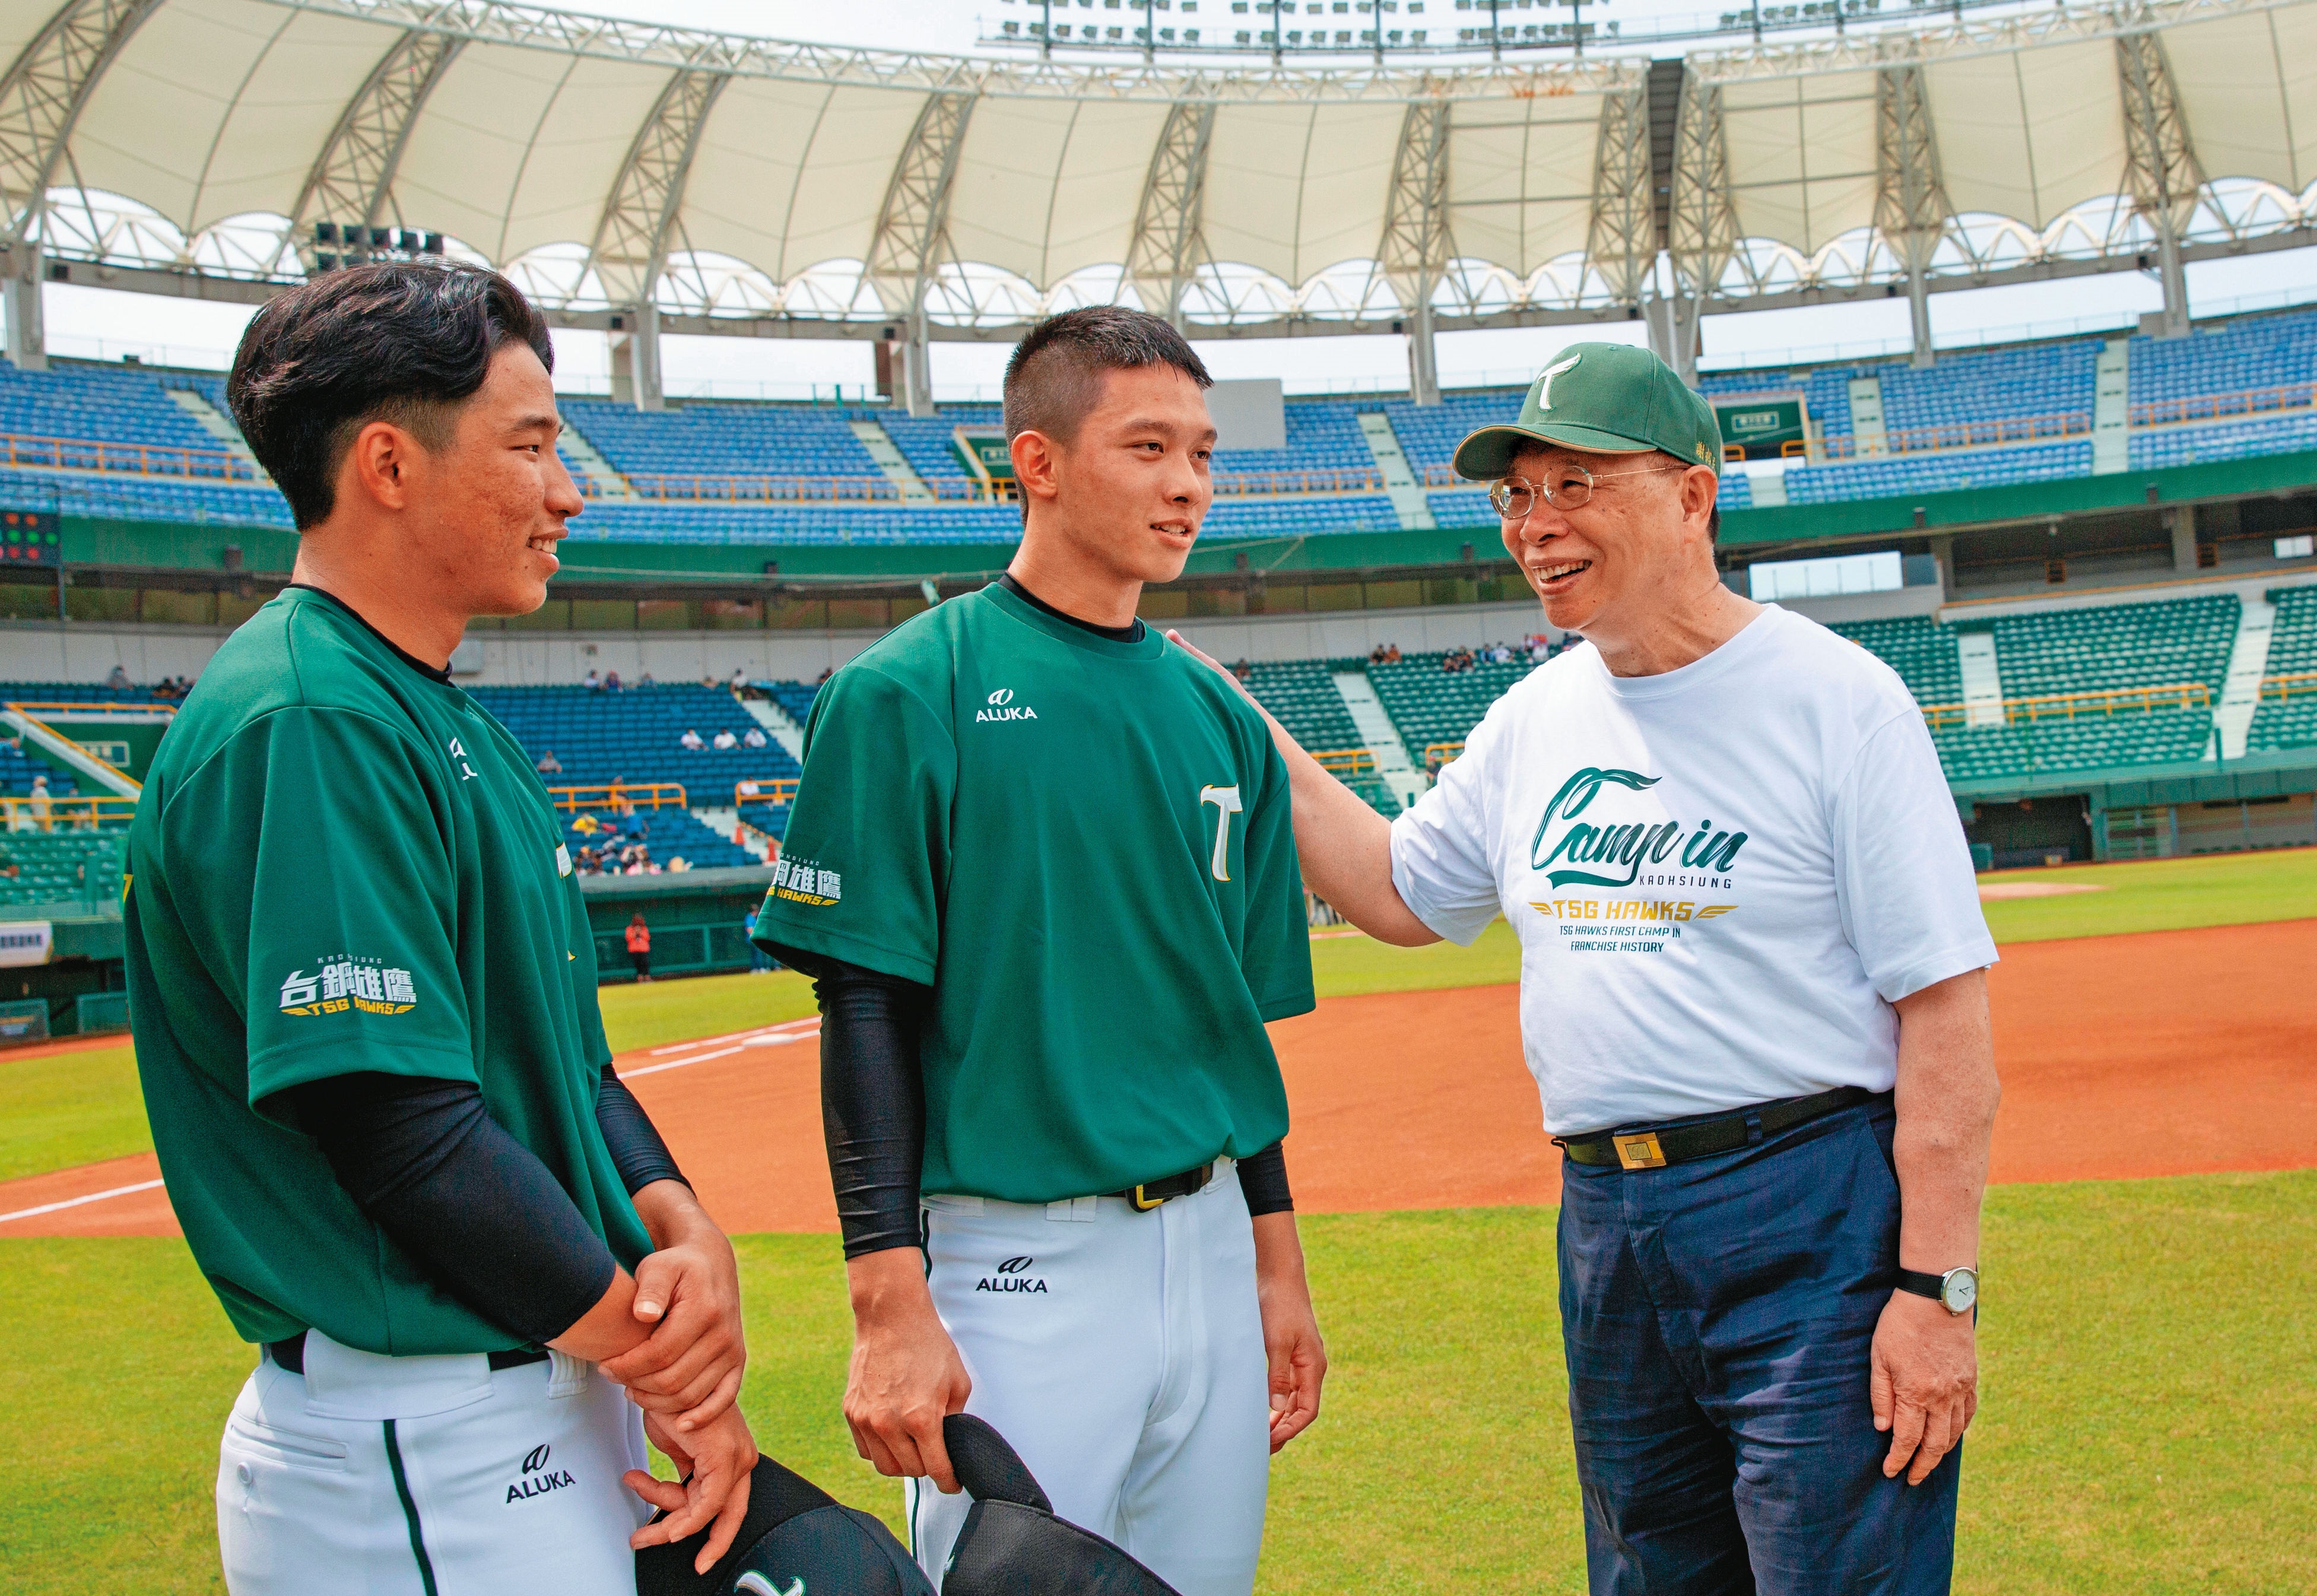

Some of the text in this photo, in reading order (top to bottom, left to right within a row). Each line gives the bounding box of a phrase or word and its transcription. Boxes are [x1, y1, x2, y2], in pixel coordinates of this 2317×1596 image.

[976, 706, 1038, 723] ALUKA
[1531, 767, 1748, 890] Camp in
[1639, 875, 1732, 889] KAOHSIUNG
[777, 887, 823, 906] HAWKS
[1552, 899, 1695, 921] TSG HAWKS
[1560, 925, 1681, 938] TSG HAWKS FIRST CAMP IN
[1571, 941, 1664, 953] FRANCHISE HISTORY
[307, 998, 350, 1016] TSG
[976, 1278, 1048, 1293] ALUKA
[506, 1470, 576, 1504] ALUKA
